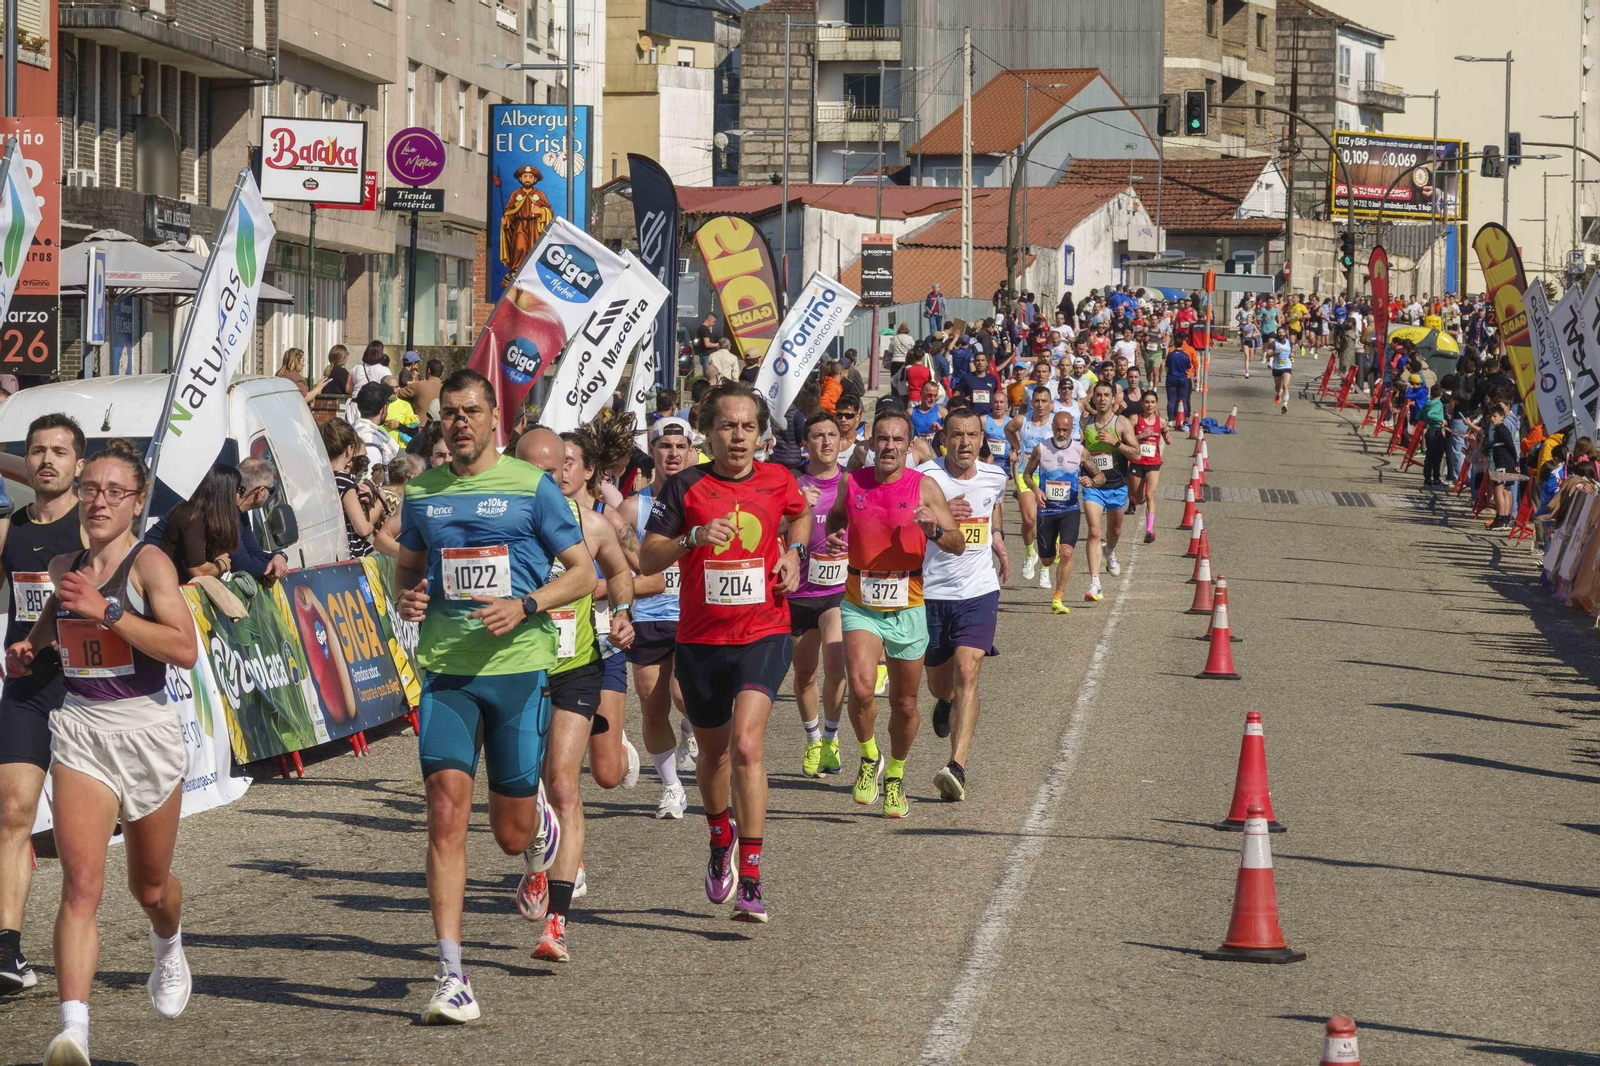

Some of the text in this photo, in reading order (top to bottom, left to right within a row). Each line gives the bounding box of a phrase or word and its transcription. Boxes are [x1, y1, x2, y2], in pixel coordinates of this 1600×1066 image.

[265, 127, 358, 170] Baraka
[496, 132, 583, 153] El Cristo
[1338, 136, 1350, 145] LUZ
[1350, 139, 1355, 147] y
[1355, 137, 1367, 146] GAS
[1343, 149, 1369, 165] 0,109
[1388, 152, 1417, 168] 0,069
[397, 190, 432, 200] Tienda
[1359, 187, 1366, 195] TU
[392, 200, 436, 210] esotérica
[547, 245, 593, 289] Giga
[601, 298, 649, 370] Maceira
[773, 288, 837, 377] O Porriño
[3, 329, 49, 363] 26
[506, 345, 537, 373] Giga
[1540, 372, 1558, 394] O
[1051, 487, 1064, 498] 183
[433, 506, 454, 515] ence
[965, 528, 981, 544] 29
[454, 564, 498, 590] 1022
[817, 564, 842, 580] 207
[719, 575, 753, 597] 204
[872, 583, 898, 600] 372
[327, 589, 385, 665] GIGA
[82, 640, 103, 666] 18
